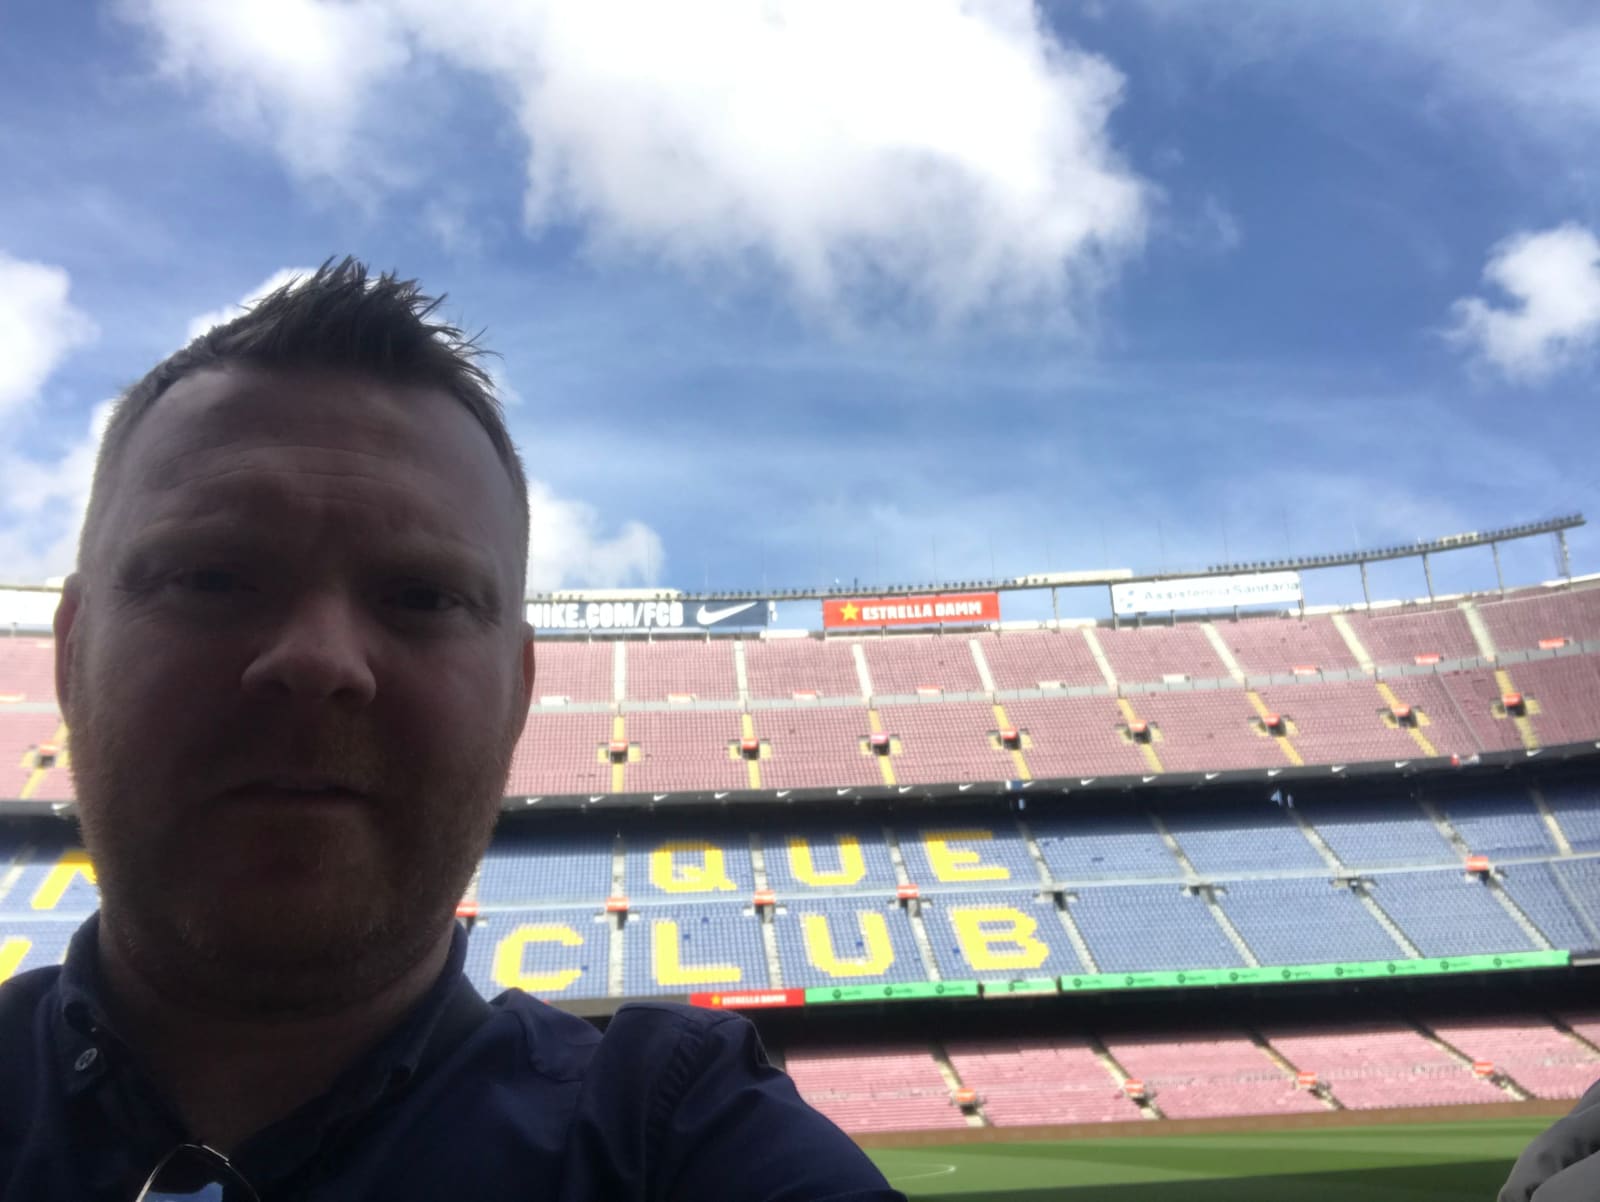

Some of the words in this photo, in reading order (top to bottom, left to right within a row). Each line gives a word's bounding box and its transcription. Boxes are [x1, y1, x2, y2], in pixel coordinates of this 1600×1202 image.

[526, 601, 684, 629] NIKE.COM/FCB
[862, 604, 933, 621] ESTRELLA
[934, 601, 983, 617] DAMM
[648, 830, 1011, 893] QUE
[493, 906, 1050, 992] CLUB
